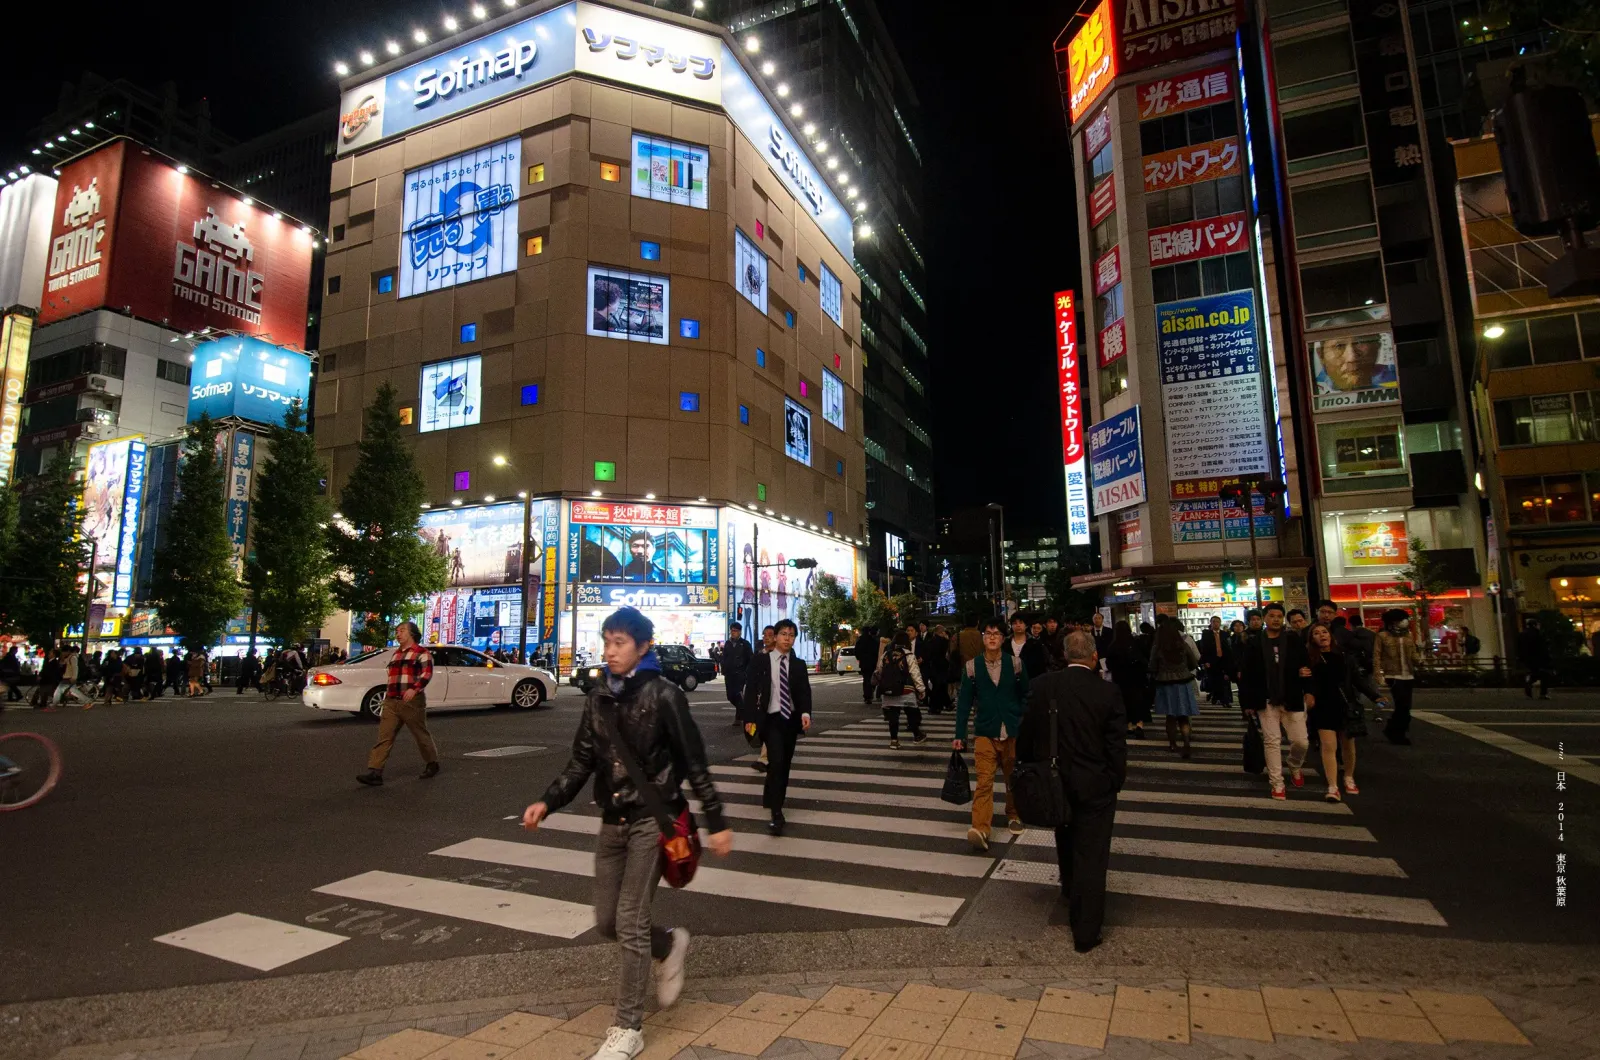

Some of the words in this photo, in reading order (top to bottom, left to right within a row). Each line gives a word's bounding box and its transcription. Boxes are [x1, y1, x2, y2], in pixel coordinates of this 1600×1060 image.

[583, 27, 716, 80] ソフマップ
[1071, 12, 1104, 85] 光
[413, 39, 537, 107] Sofmap
[411, 153, 515, 192] 売るのも買うのもサポートも
[768, 123, 824, 216] Sofmap
[1145, 143, 1238, 187] ネットワーク
[475, 184, 514, 224] 買う
[50, 219, 106, 276] GAME
[408, 213, 463, 269] 売る
[1150, 220, 1244, 261] 配線パーツ
[48, 274, 69, 292] TAITO
[69, 262, 100, 286] STATION
[173, 241, 264, 310] GAME
[427, 255, 488, 281] ソフマップ
[173, 282, 208, 307] TAITO
[212, 299, 261, 325] STATION
[1162, 306, 1250, 334] aisan.co.jp
[192, 382, 233, 402] Sofmap
[1057, 296, 1081, 457] 光・ケーブル・ネットワーク
[1068, 472, 1088, 535] 愛三電機
[1096, 479, 1140, 510] AISAN
[610, 588, 683, 607] Sofmap
